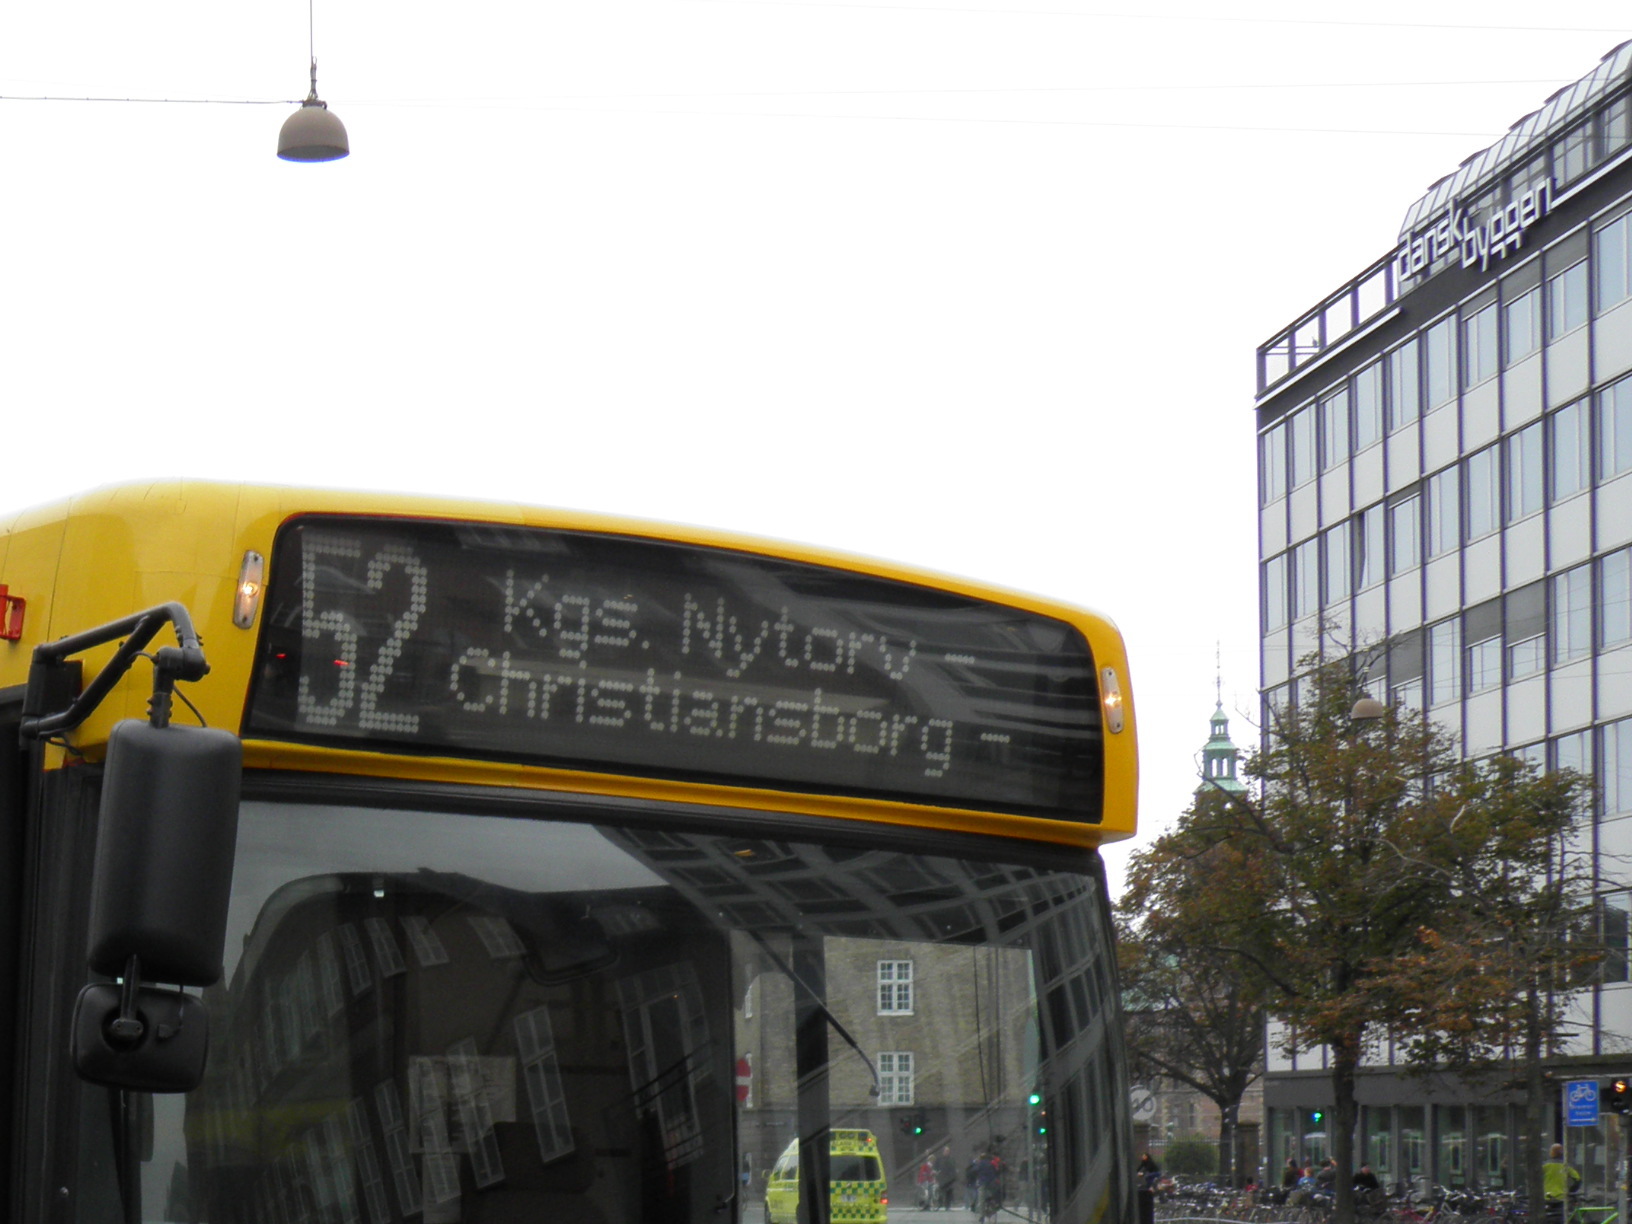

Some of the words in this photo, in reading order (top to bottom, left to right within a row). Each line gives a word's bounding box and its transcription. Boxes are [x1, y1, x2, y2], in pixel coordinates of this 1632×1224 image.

[1397, 198, 1464, 282] dansk
[1461, 176, 1553, 272] byggen
[298, 533, 428, 734] 52
[502, 569, 649, 669] Kgs.
[681, 592, 916, 680] Nytorv
